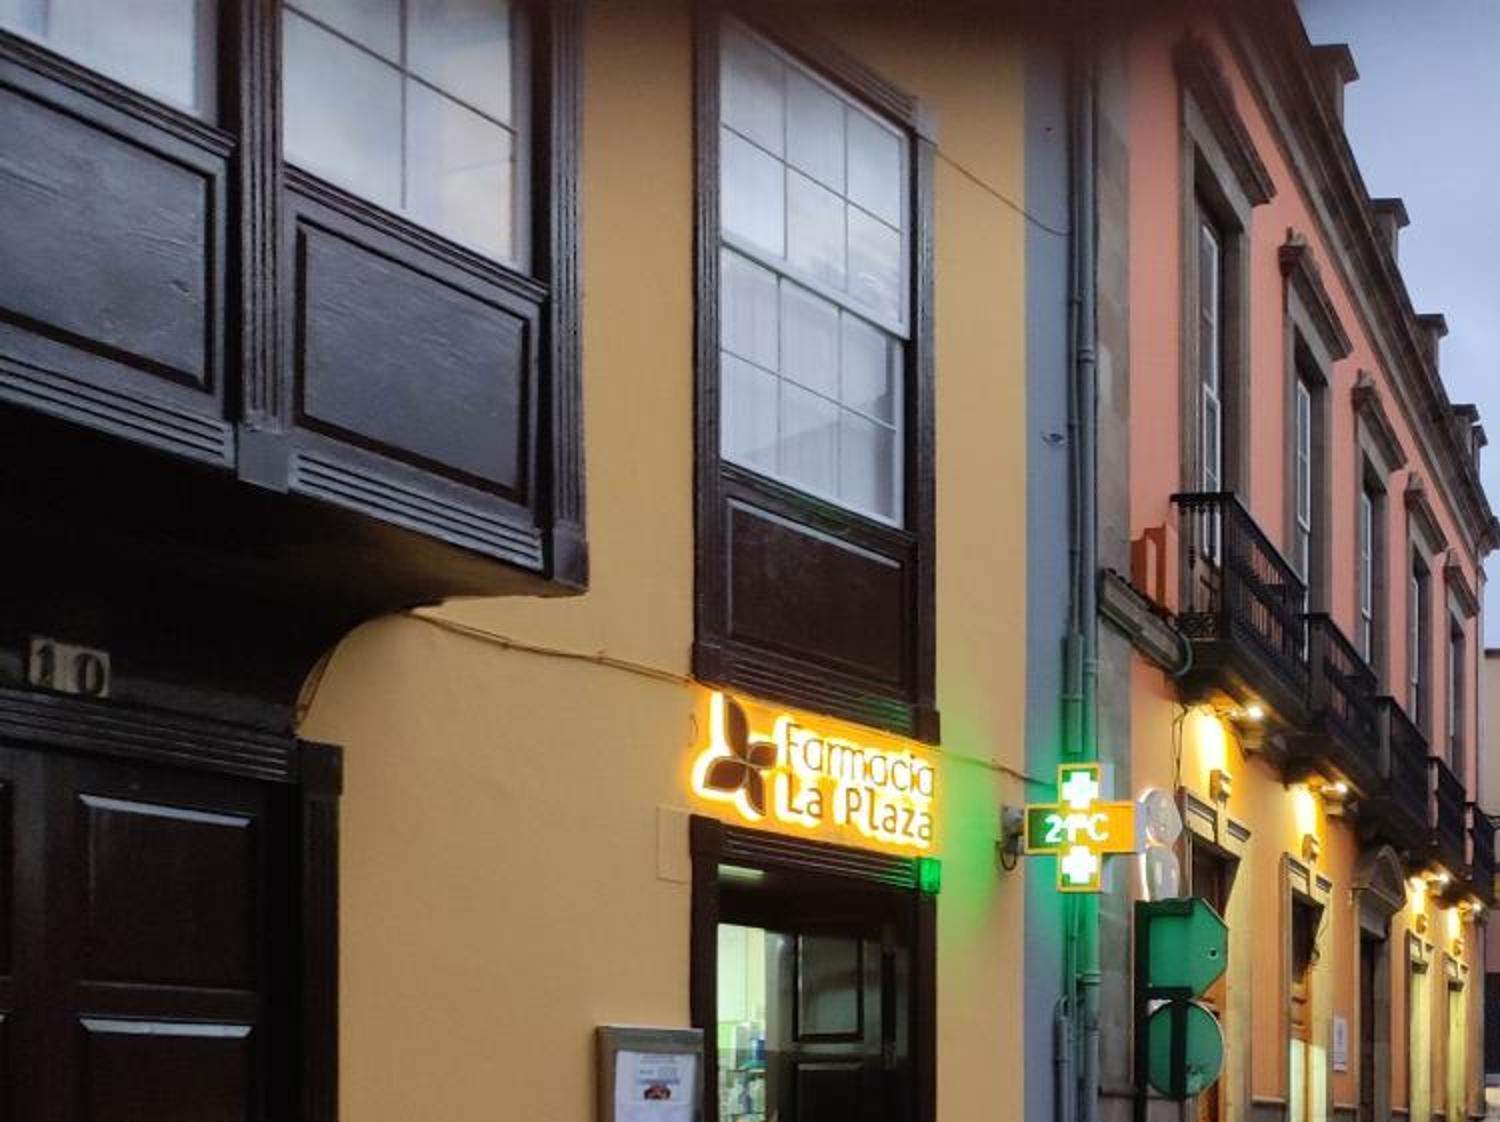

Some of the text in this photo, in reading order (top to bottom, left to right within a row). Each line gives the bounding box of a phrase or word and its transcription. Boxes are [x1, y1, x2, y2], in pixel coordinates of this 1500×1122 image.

[36, 643, 105, 696] 10
[784, 721, 935, 798] Farmacia
[786, 773, 934, 842] La Plaza
